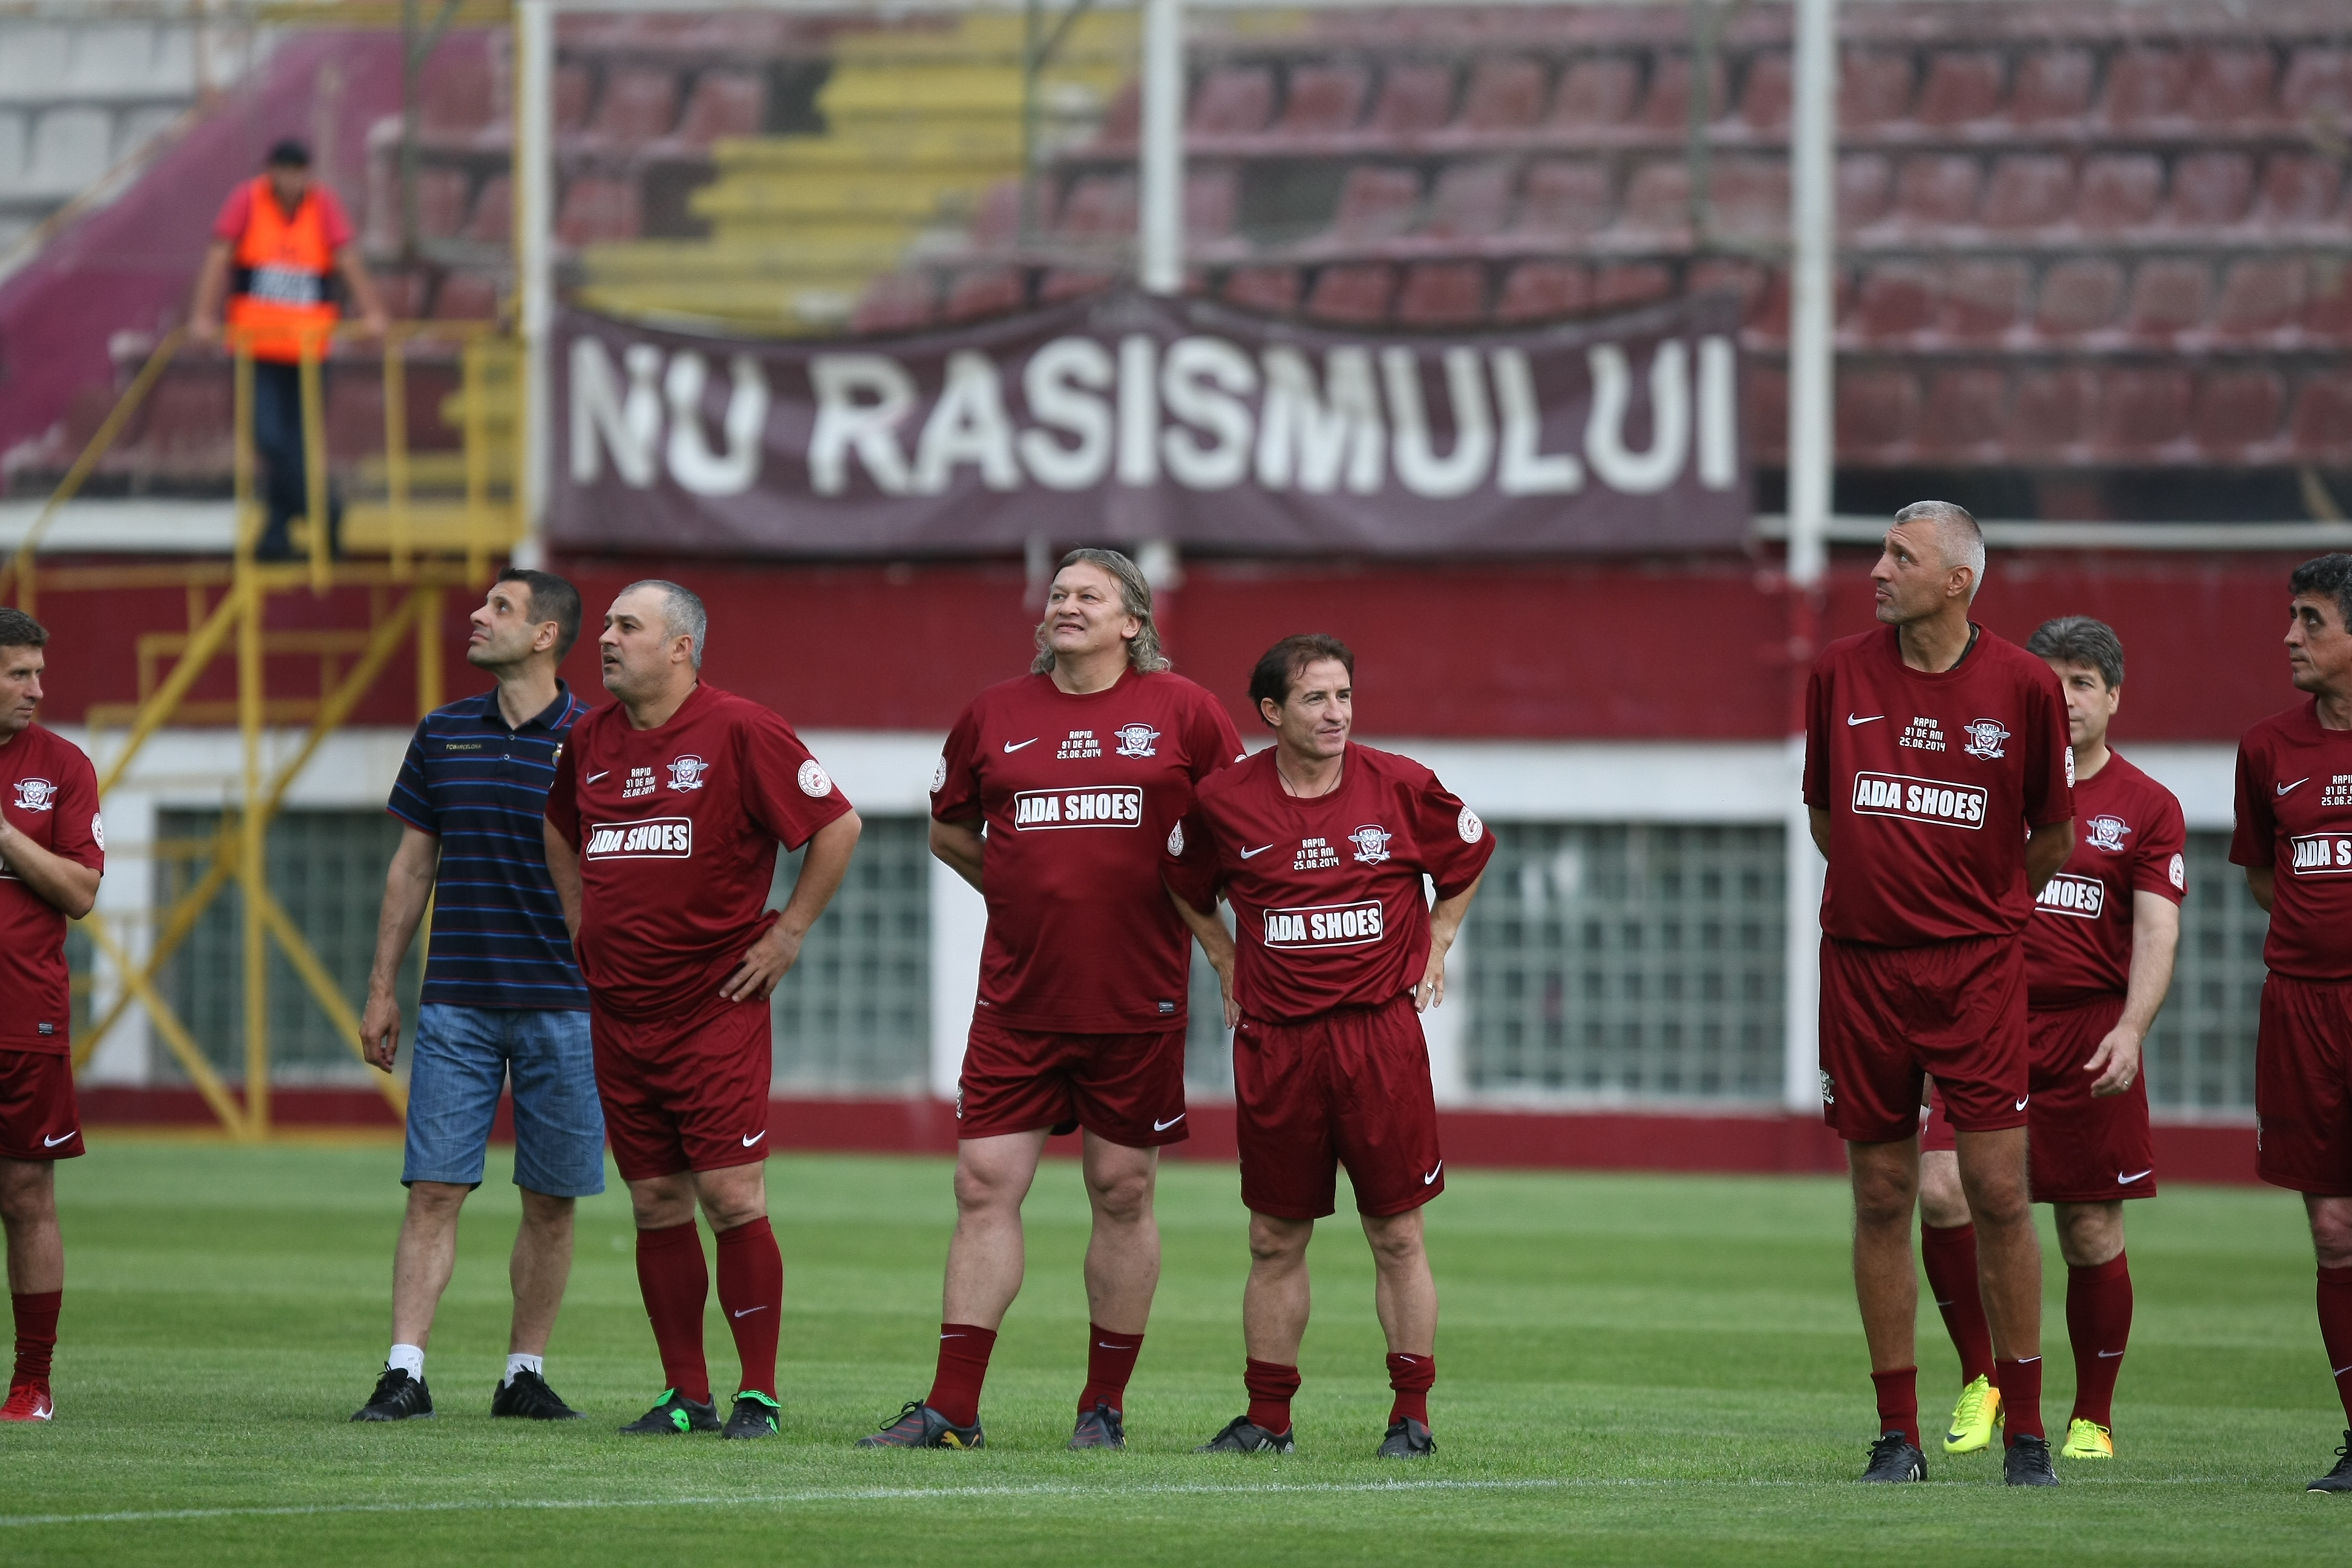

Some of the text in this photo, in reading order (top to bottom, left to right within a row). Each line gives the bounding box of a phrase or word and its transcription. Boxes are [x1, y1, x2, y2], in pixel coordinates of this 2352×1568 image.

[569, 334, 1736, 497] NU RASISMULUI
[1913, 716, 1938, 728] RAPID
[1069, 730, 1093, 739] RAPID
[1904, 727, 1944, 740] 91 DE ANI
[1061, 739, 1098, 750] 91 DE ANI
[1899, 737, 1946, 752] 25.06.2014
[1056, 748, 1101, 759] 25.06.2014
[631, 767, 651, 777] RAPID
[626, 776, 655, 788] 91 DE ANI
[622, 785, 655, 798] 25.06.2014
[2325, 785, 2347, 795] 91 DE
[1856, 779, 1983, 822] ADA SHOES
[2321, 795, 2352, 806] 25.06.2
[1017, 793, 1138, 823] ADA SHOES
[587, 825, 688, 854] ADA SHOES
[1302, 838, 1325, 849] RAPID
[1296, 847, 1334, 860] 91 DE ANI
[2295, 840, 2331, 867] ADA
[1293, 857, 1339, 870] 25.06.2014
[2036, 880, 2100, 912] HOES
[1268, 907, 1380, 941] ADA SHOES
